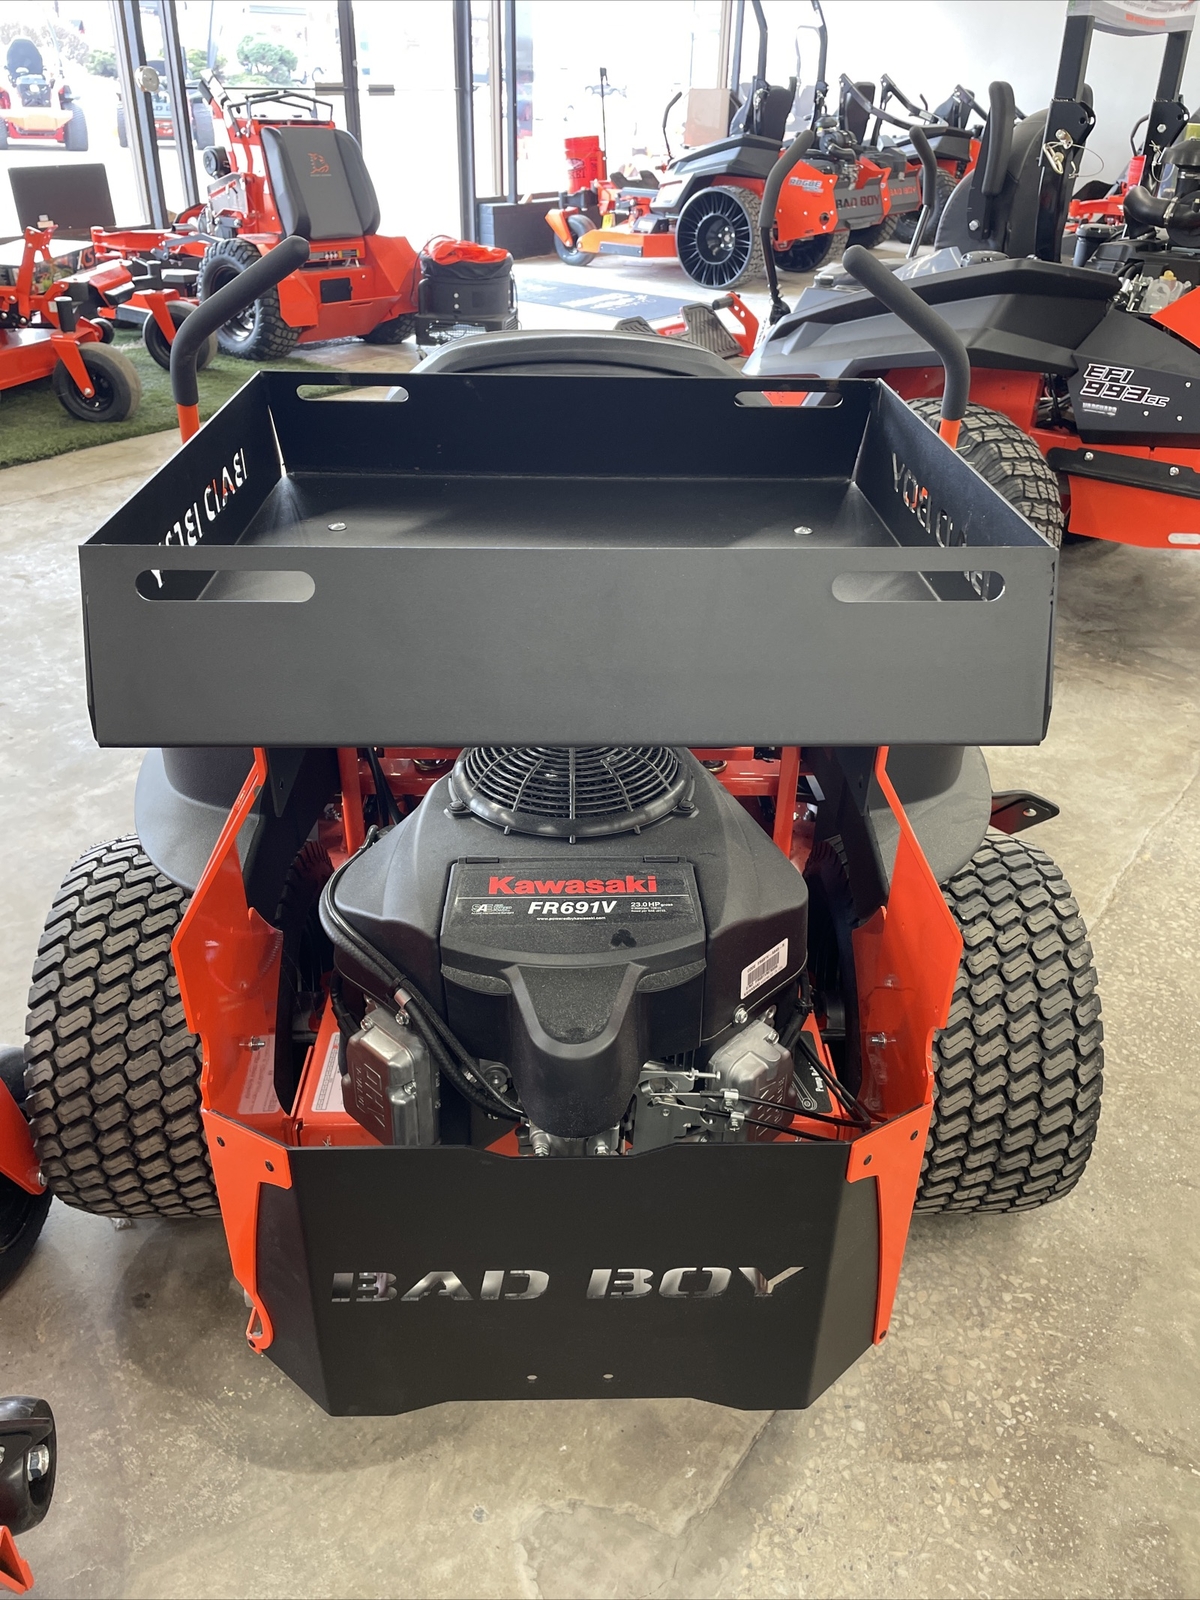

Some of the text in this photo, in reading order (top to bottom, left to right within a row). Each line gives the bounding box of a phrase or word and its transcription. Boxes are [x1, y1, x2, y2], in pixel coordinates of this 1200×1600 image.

[788, 177, 823, 188] ROGUE
[890, 186, 917, 196] BAD BOY
[836, 195, 880, 209] BAD BOY
[1083, 363, 1135, 384] EFI
[488, 875, 657, 895] Kawasaki
[527, 900, 618, 915] FR691V
[331, 1266, 805, 1302] BAD BOY
